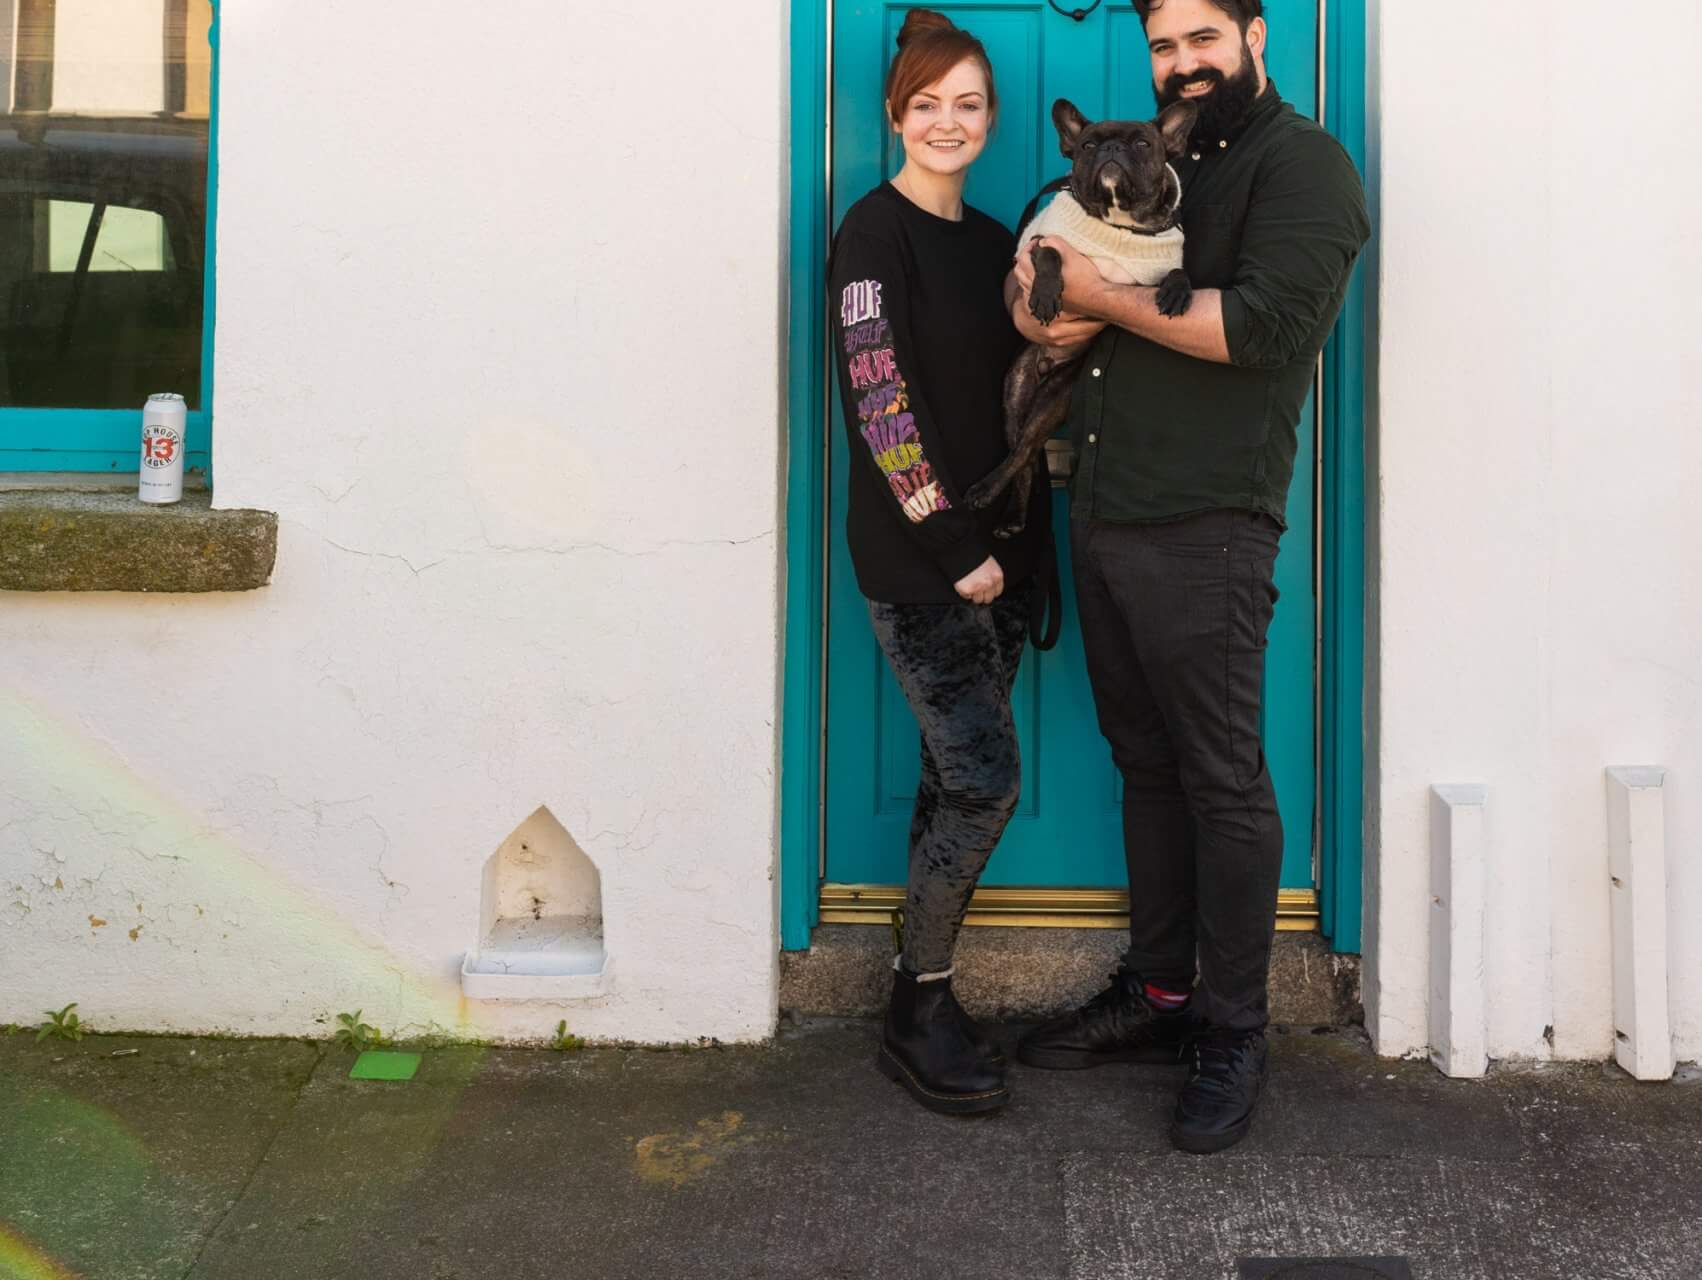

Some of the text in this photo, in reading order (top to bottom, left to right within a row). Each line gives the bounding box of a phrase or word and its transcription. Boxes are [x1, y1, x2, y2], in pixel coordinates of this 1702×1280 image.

[841, 279, 882, 327] HUF
[849, 348, 897, 389] HUF
[143, 437, 174, 459] 13
[861, 412, 917, 456] HUF
[874, 442, 923, 476] HUF
